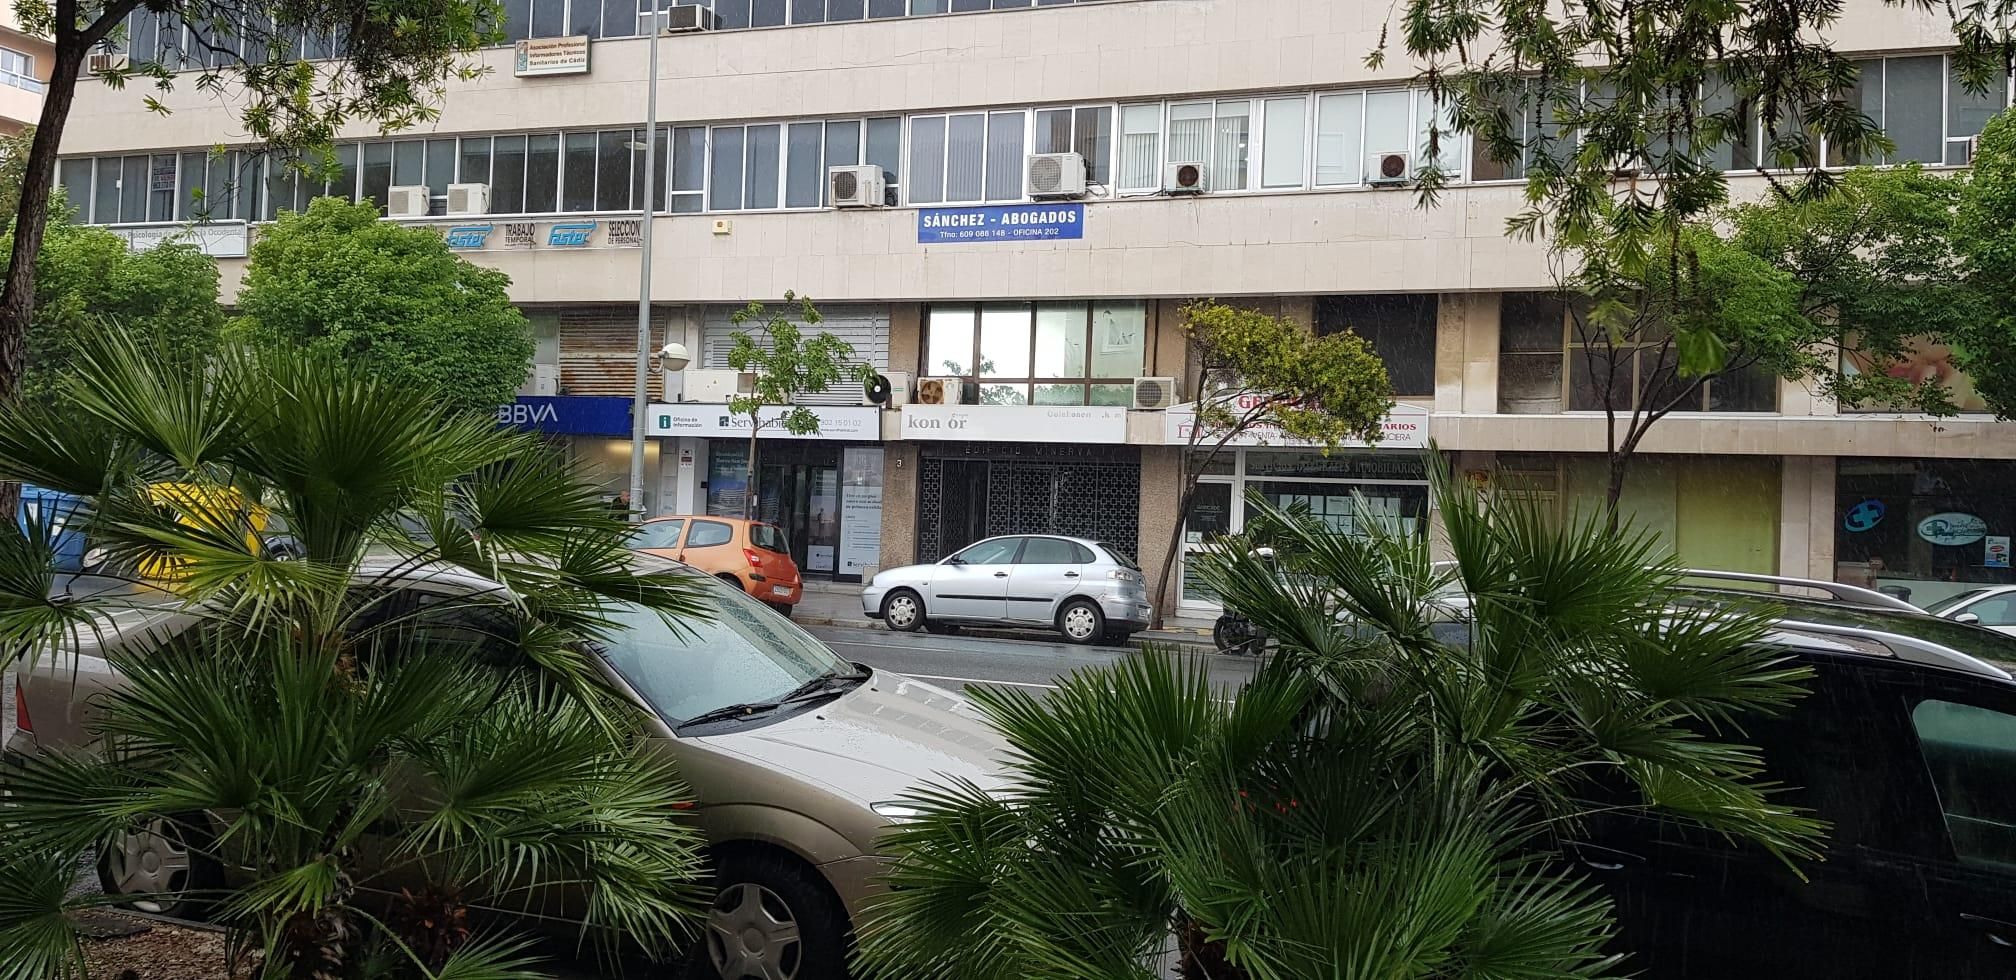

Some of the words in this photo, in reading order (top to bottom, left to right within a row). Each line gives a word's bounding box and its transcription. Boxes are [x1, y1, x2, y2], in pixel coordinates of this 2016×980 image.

[923, 213, 985, 228] SÁNCHEZ
[1001, 210, 1076, 225] ABOGADOS
[505, 223, 536, 237] TRABAJO
[940, 231, 958, 239] Tfno:
[1044, 227, 1059, 235] 202
[504, 236, 534, 244] TEMPORAL
[608, 237, 614, 245] DE
[498, 402, 558, 424] BBVA
[1035, 447, 1092, 456] MINERVA
[896, 459, 902, 468] 3
